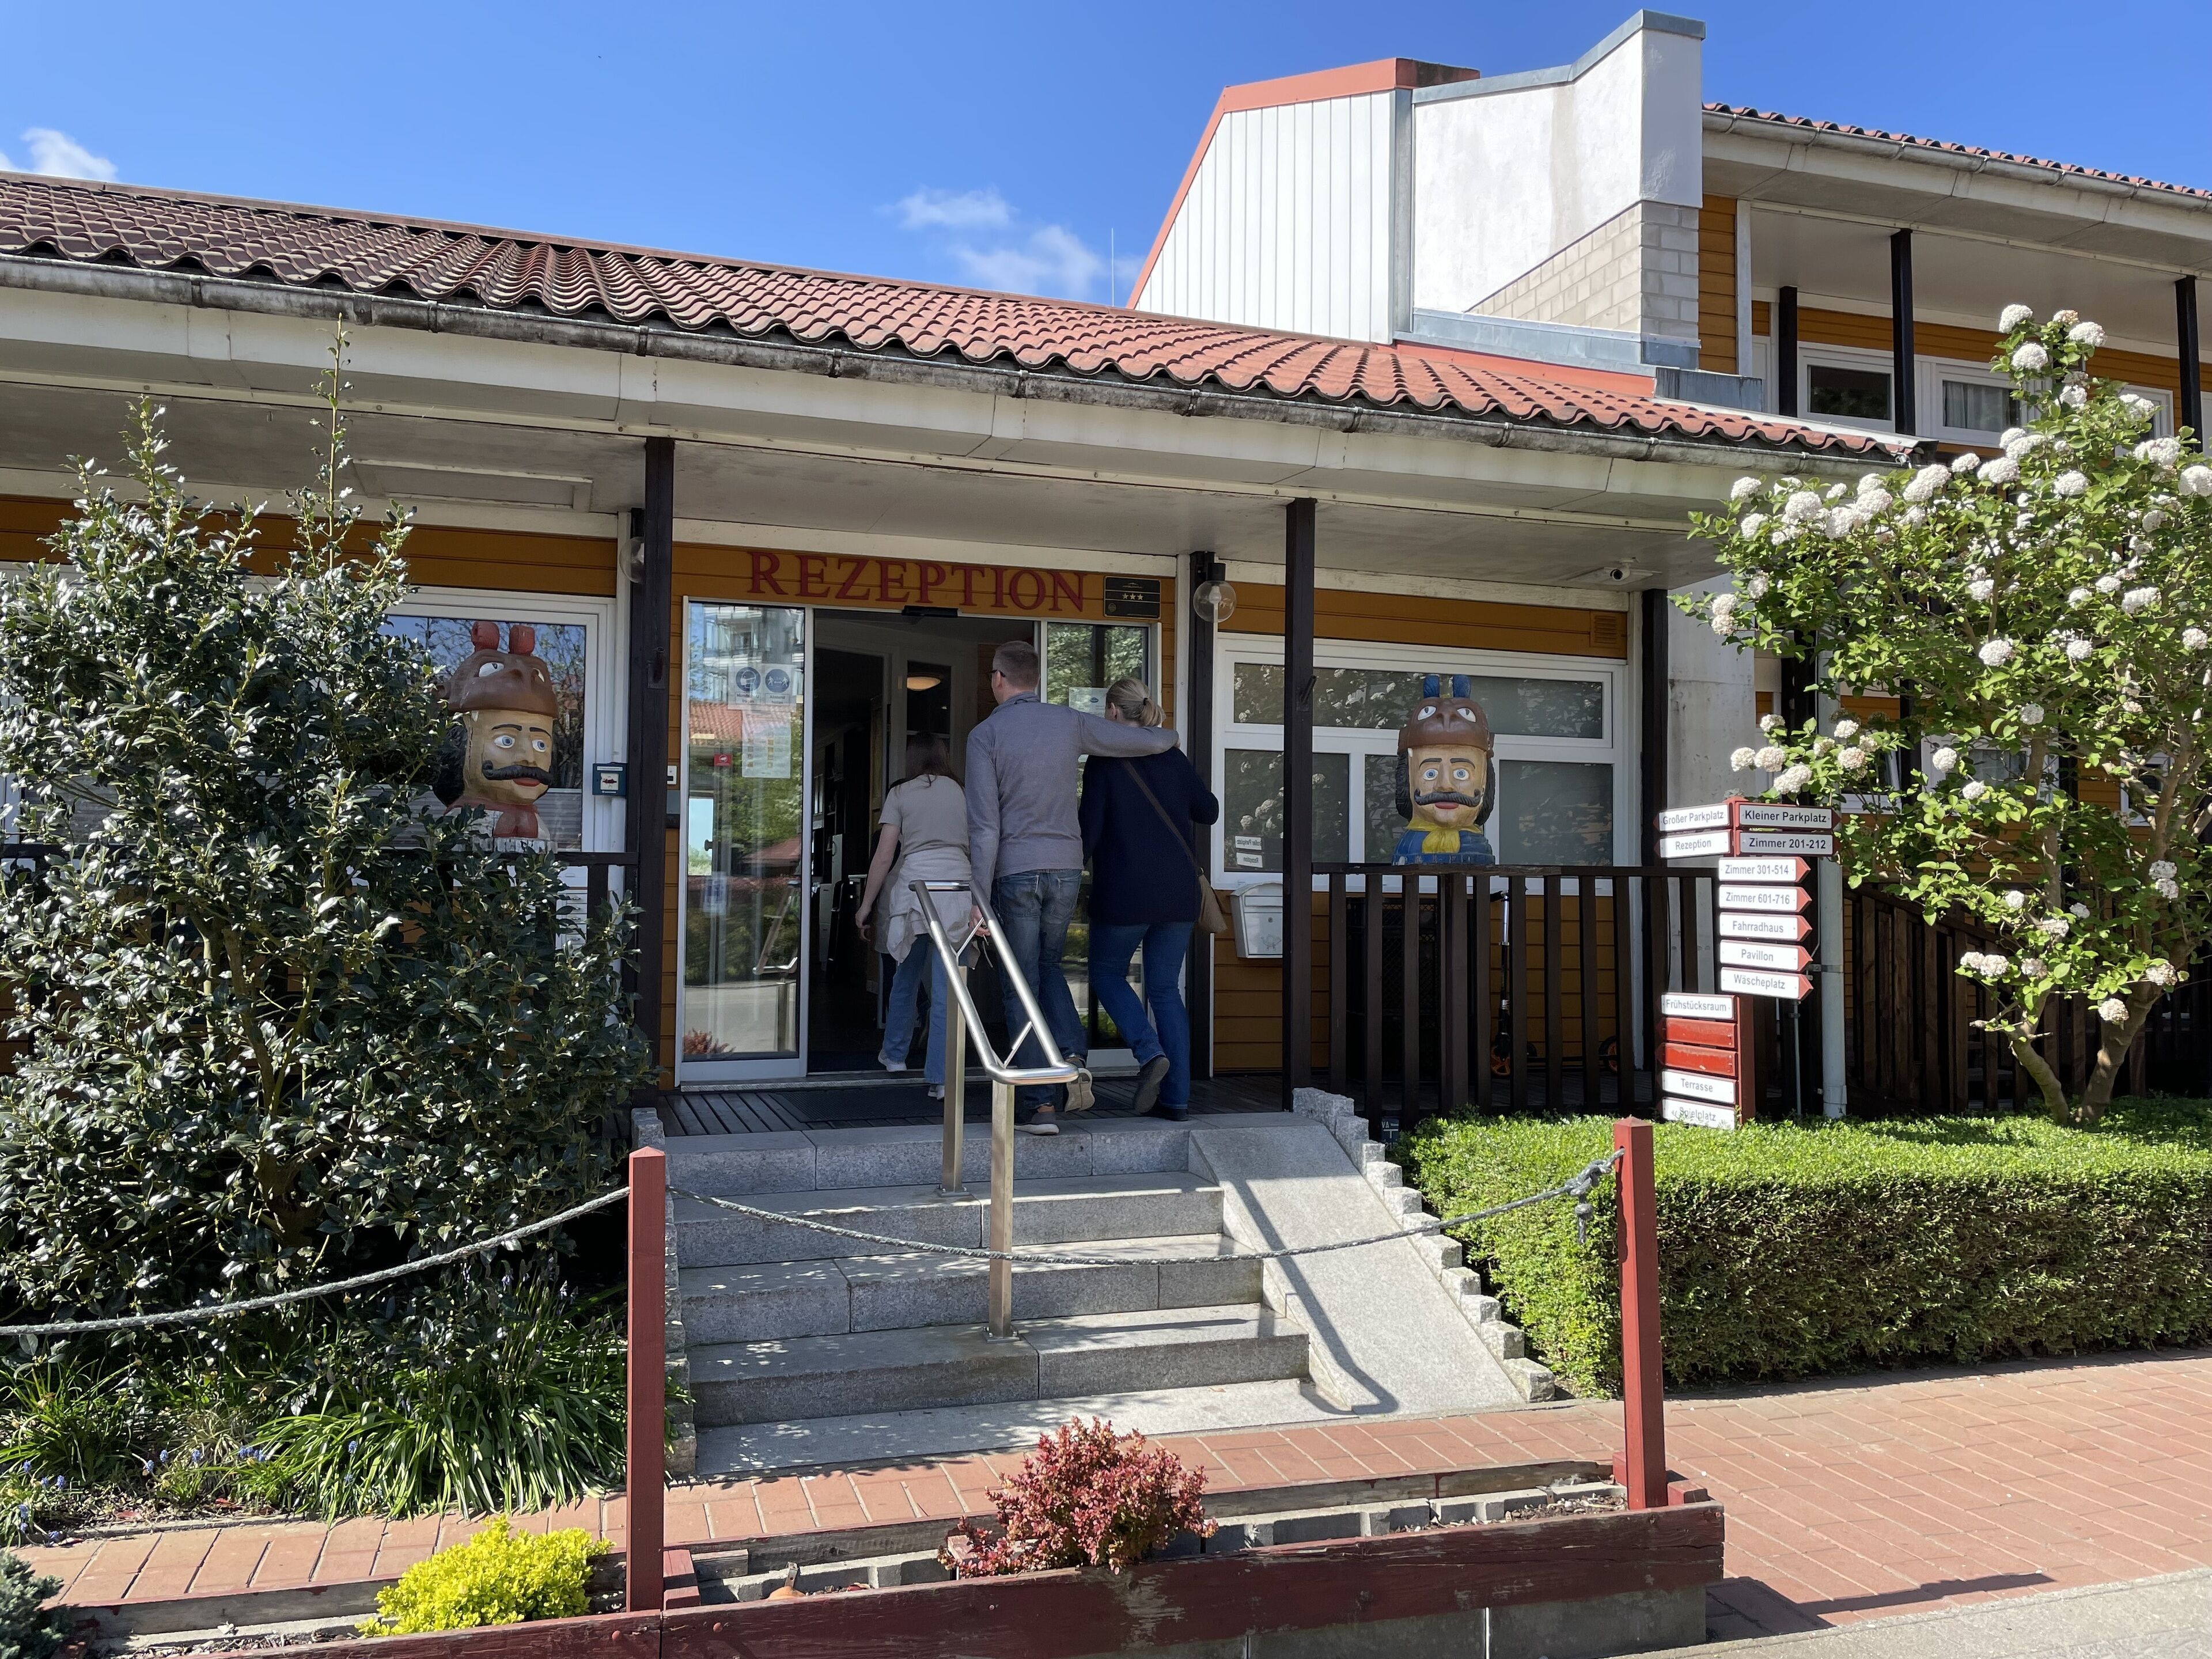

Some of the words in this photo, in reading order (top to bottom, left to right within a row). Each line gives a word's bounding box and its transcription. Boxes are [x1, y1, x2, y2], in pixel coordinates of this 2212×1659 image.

[747, 552, 1085, 612] REZEPTION
[1662, 816, 1687, 825] Großer
[1689, 812, 1724, 822] Parkplatz
[1745, 810, 1779, 821] Kleiner
[1782, 812, 1827, 823] Parkplatz
[1675, 839, 1711, 851] Rezeption
[1749, 838, 1786, 848] Zimmer
[1789, 839, 1826, 849] 201-212
[1725, 865, 1755, 874] Zimmer
[1757, 865, 1789, 874] 301-514
[1726, 892, 1756, 903] Zimmer
[1758, 893, 1790, 904] 601-716
[1732, 921, 1784, 933] Fahrradhaus
[1741, 949, 1774, 961] Pavillon
[1734, 974, 1785, 990] Wäscheplatz
[1666, 999, 1727, 1012] Frühstücksraum
[1681, 1078, 1713, 1092] Terrasse
[1680, 1107, 1716, 1121] Spielplatz
